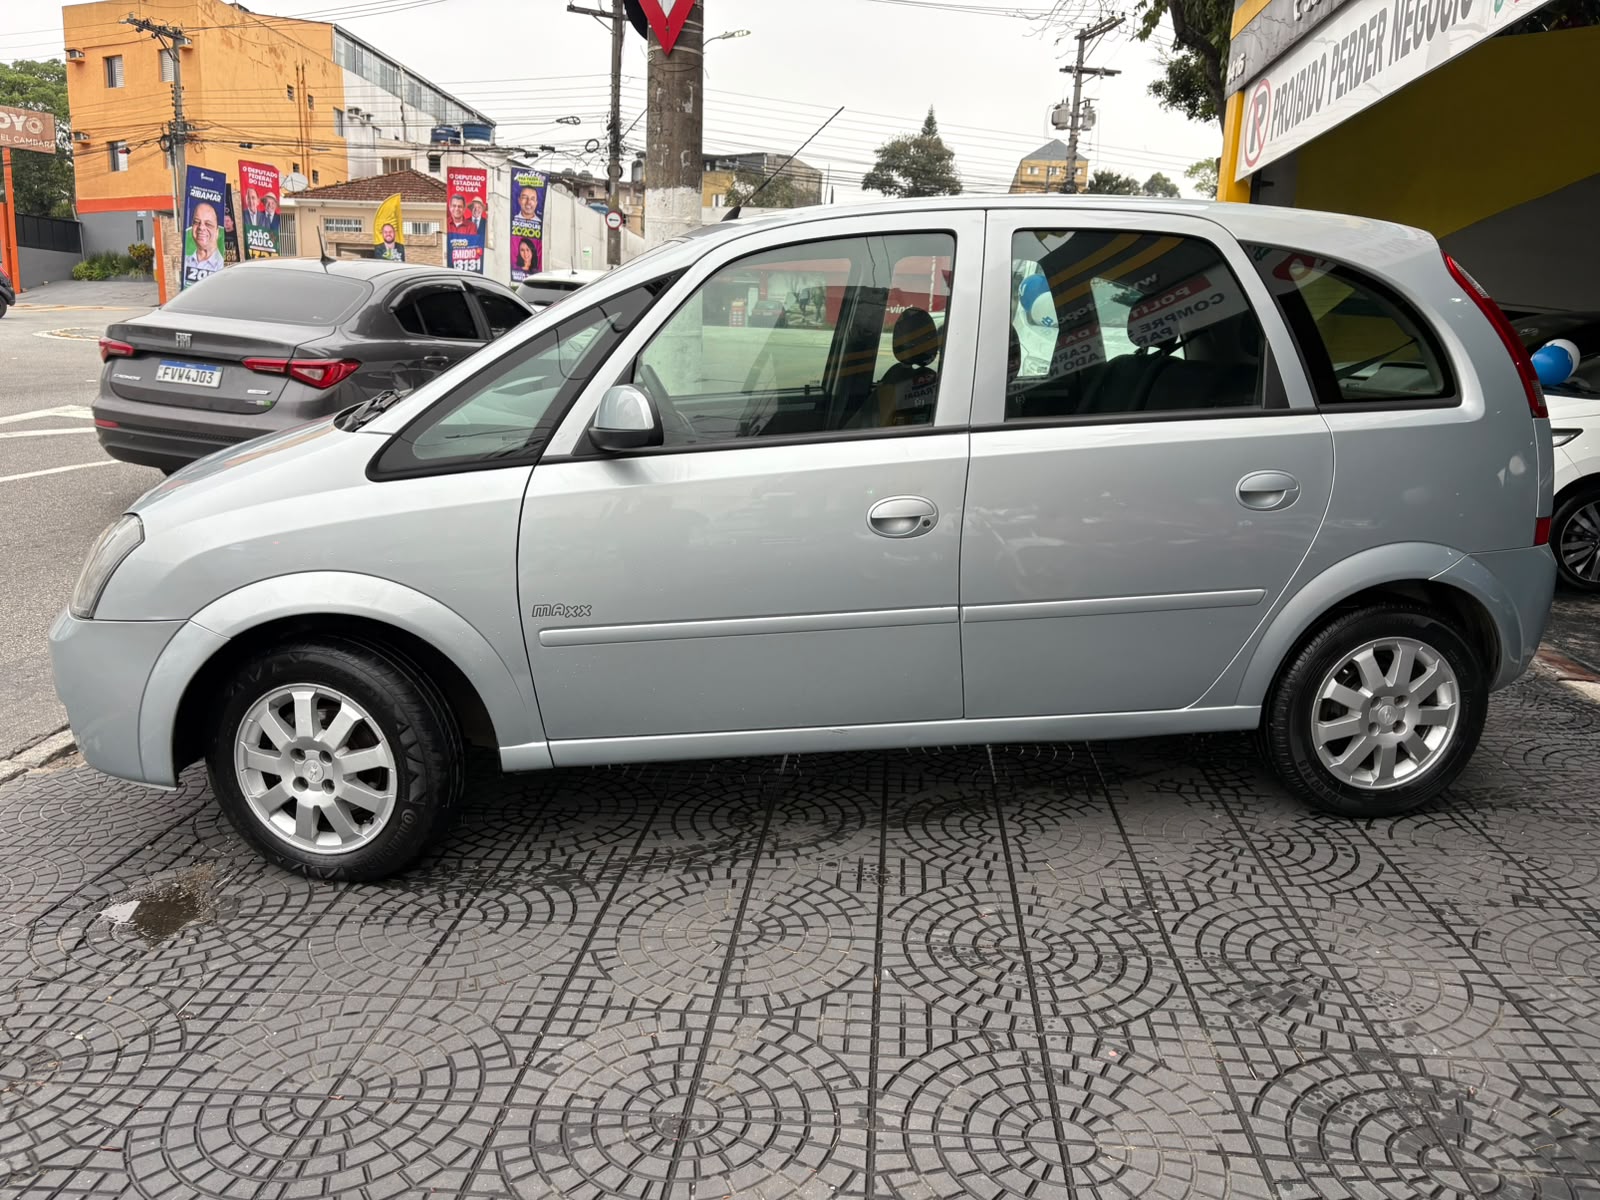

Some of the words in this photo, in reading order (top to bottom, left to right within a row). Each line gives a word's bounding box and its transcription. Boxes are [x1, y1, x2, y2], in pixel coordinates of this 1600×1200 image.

[1270, 50, 1327, 142] PROIBIDO
[1327, 7, 1388, 106] PERDER
[247, 167, 278, 179] DEPUTADO
[248, 173, 273, 183] FEDERAL
[454, 174, 486, 182] DEPUTADO
[258, 181, 273, 189] LULA
[453, 180, 482, 188] ESTADUAL
[190, 189, 222, 203] RIBAMAR
[247, 229, 270, 241] JOÃO
[247, 237, 274, 249] PAULO
[162, 366, 215, 384] FVW4J03
